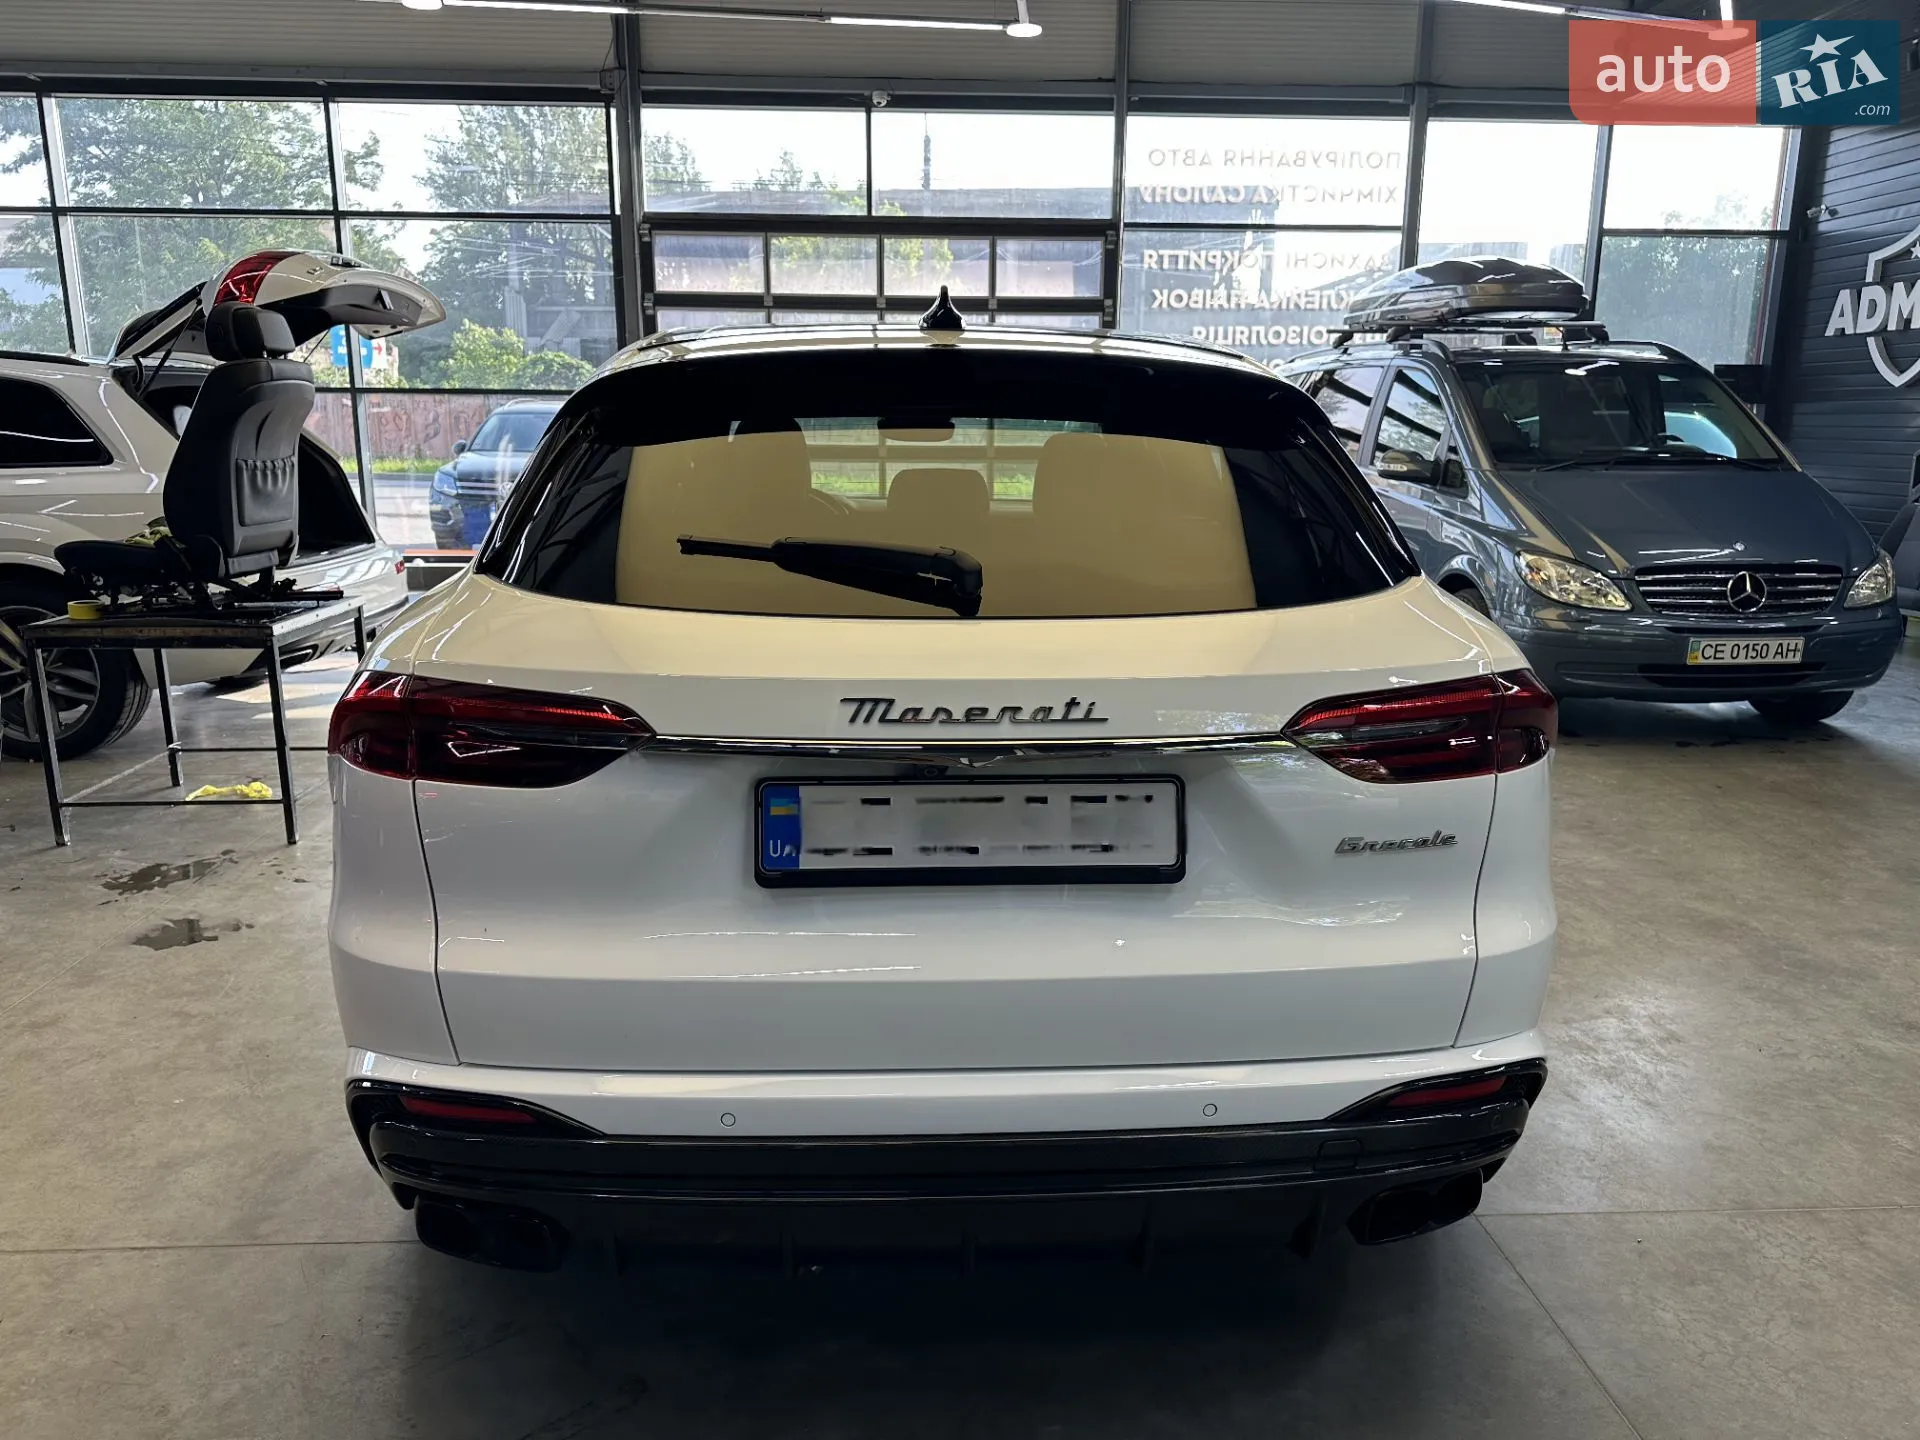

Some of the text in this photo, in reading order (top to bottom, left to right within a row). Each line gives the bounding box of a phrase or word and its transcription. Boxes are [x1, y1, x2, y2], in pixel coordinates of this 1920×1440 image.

[1701, 642, 1798, 661] CE 0150 AH
[840, 697, 1109, 724] Maserati
[1335, 829, 1459, 854] Grecale
